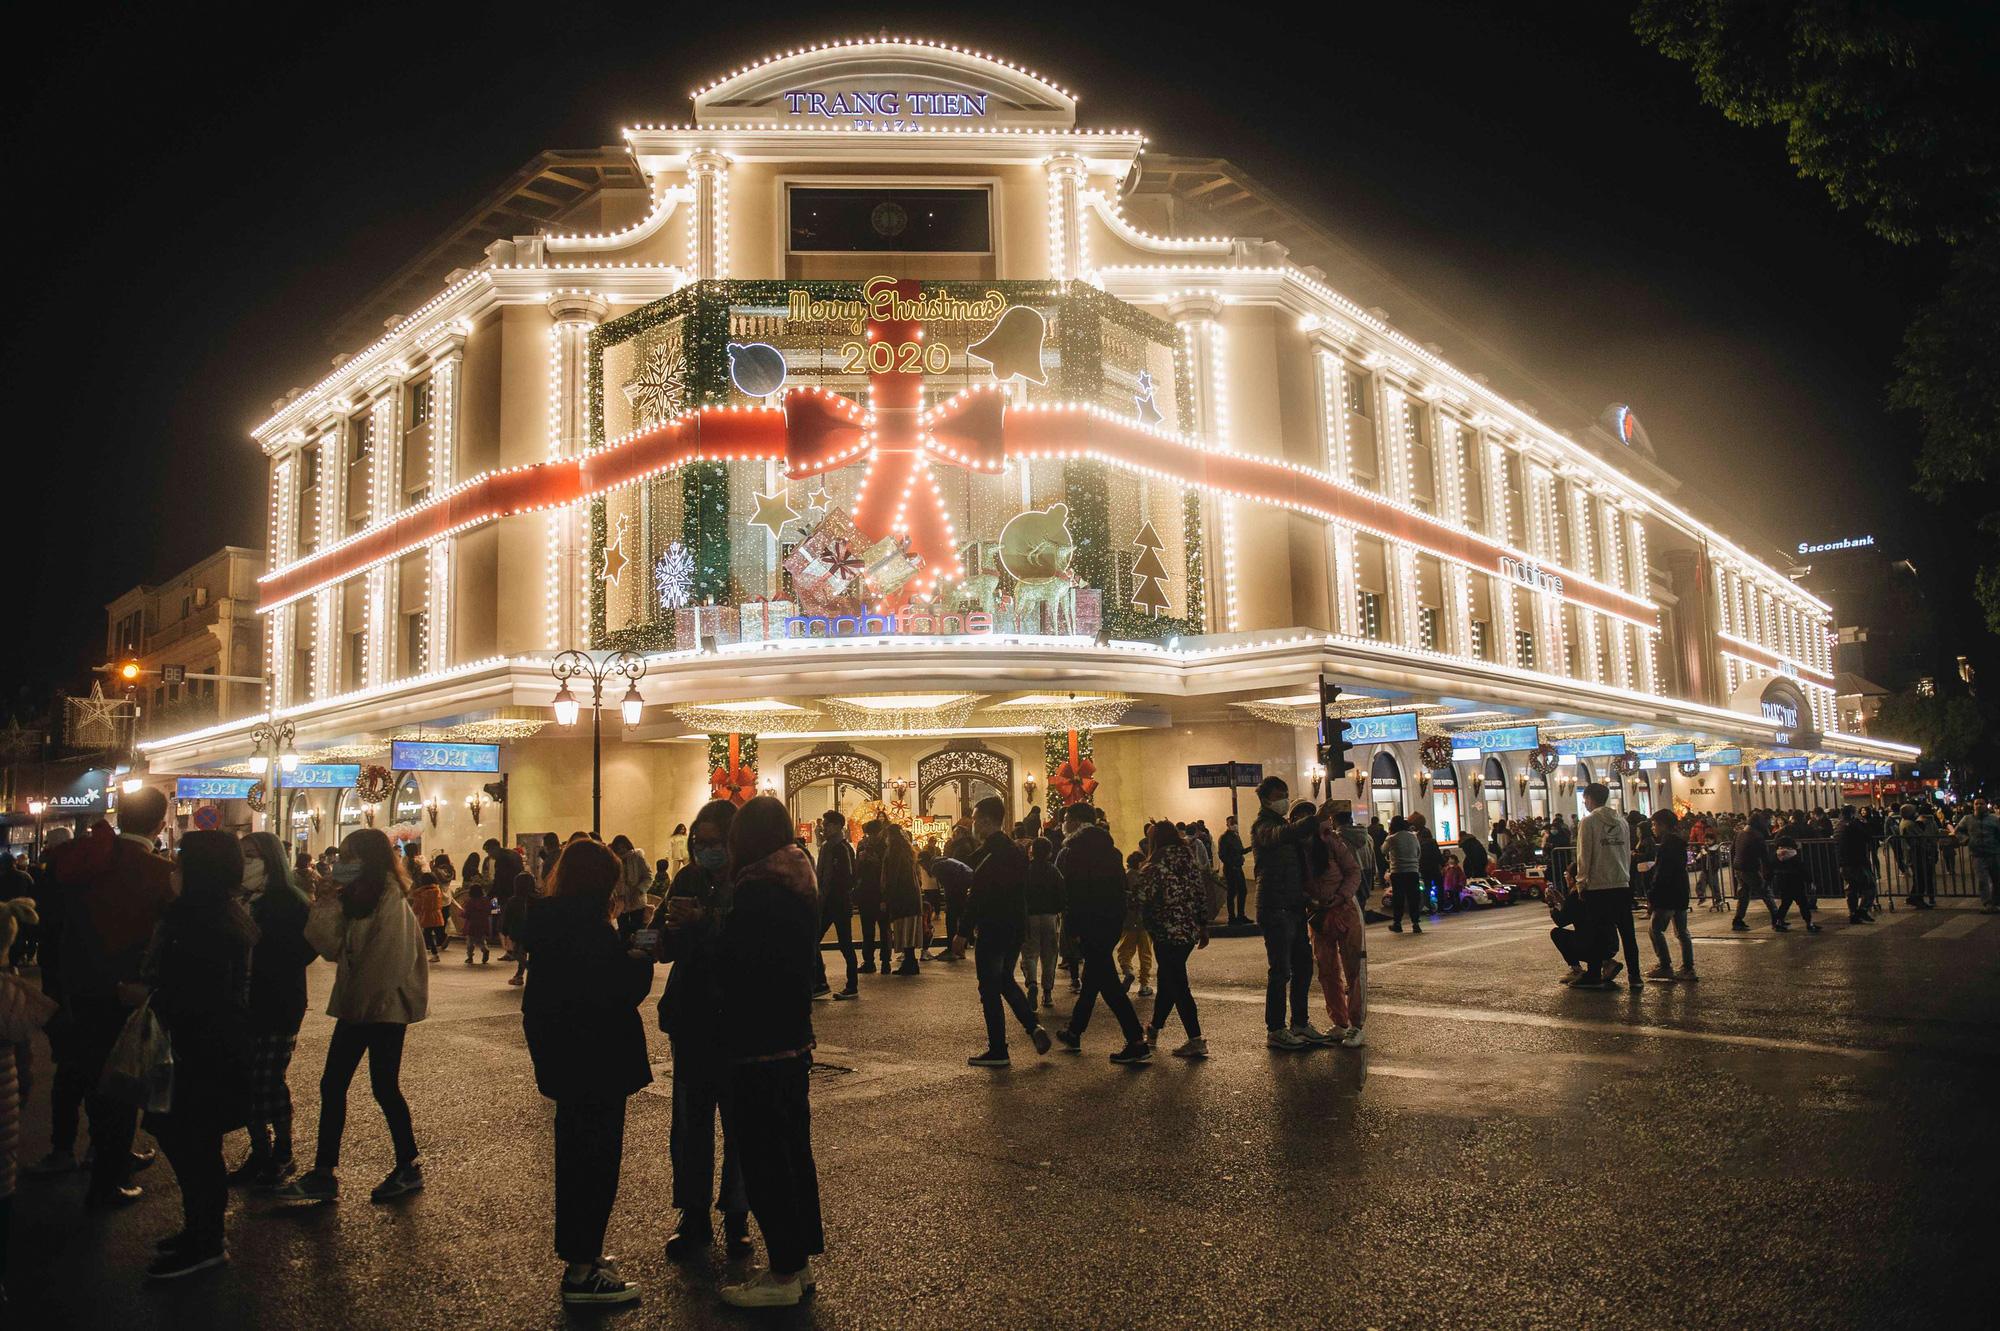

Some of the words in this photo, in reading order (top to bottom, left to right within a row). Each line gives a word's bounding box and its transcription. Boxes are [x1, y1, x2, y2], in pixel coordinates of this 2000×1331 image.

[784, 91, 900, 118] TRANG
[906, 92, 988, 117] TIEN
[853, 119, 920, 132] PLAZA
[787, 290, 868, 336] Merry
[863, 275, 1007, 321] Christmas
[840, 341, 951, 374] 2020
[1797, 535, 1875, 554] Sacombank
[784, 603, 993, 639] mobifone
[1346, 721, 1388, 741] 2021
[1475, 733, 1513, 749] 2021
[423, 747, 467, 767] 2021
[294, 768, 333, 784] 2021
[199, 781, 237, 795] 2021
[60, 796, 90, 805] BANK
